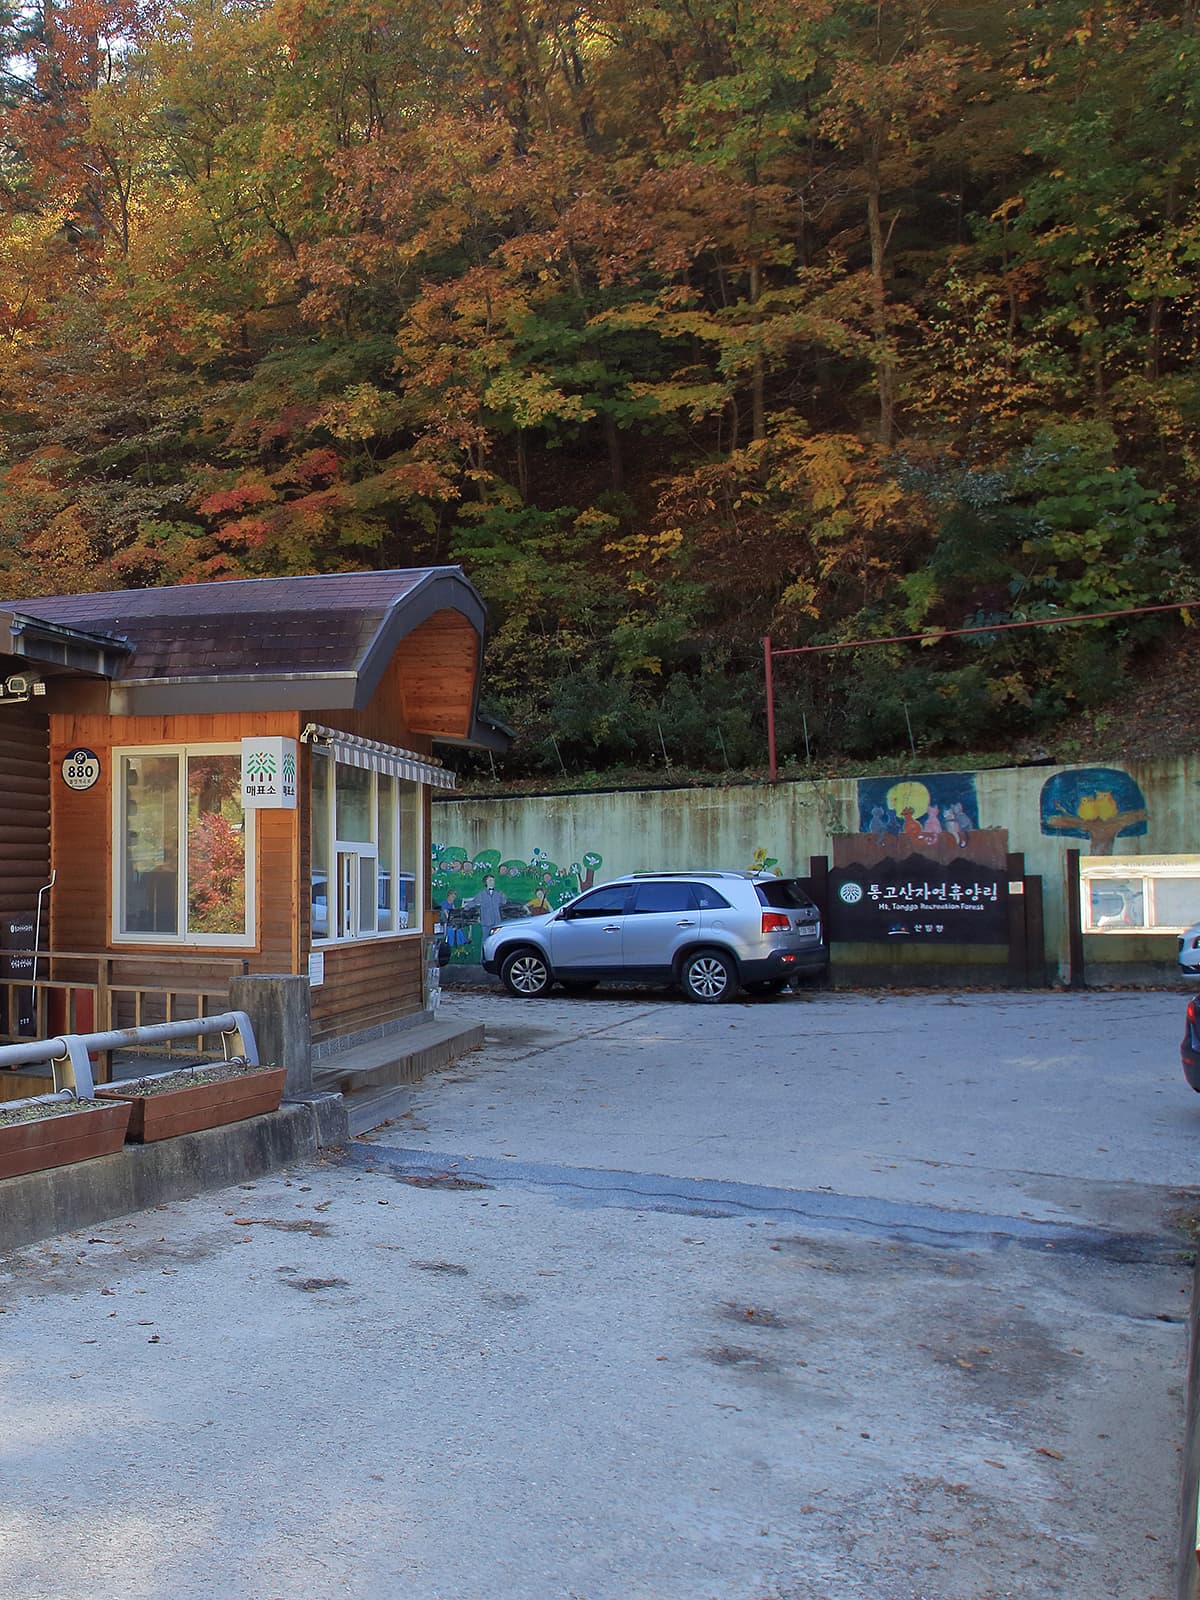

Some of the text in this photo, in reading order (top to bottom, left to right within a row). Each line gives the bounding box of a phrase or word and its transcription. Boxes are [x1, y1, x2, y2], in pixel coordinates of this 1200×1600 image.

[68, 765, 94, 778] 880
[246, 785, 277, 797] 매표소
[867, 882, 998, 901] 통고산자연휴양림
[920, 902, 960, 911] Recreation
[960, 902, 985, 911] Forest
